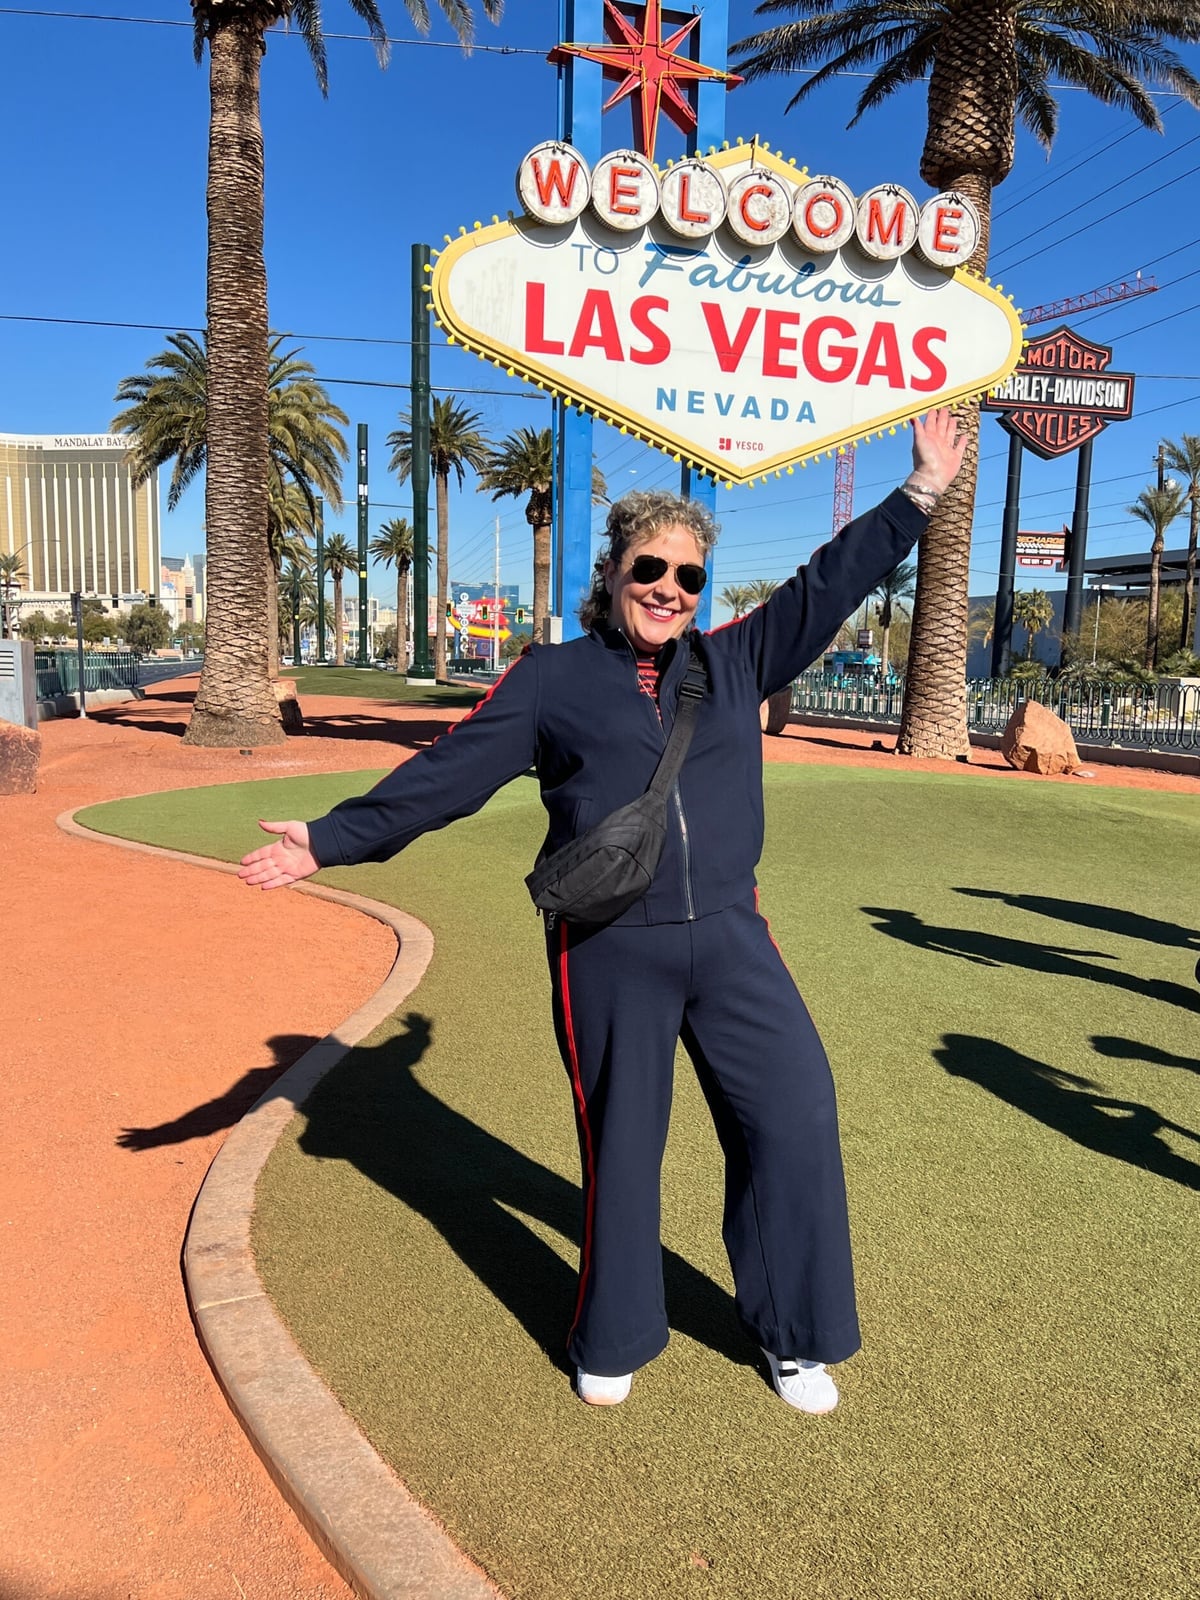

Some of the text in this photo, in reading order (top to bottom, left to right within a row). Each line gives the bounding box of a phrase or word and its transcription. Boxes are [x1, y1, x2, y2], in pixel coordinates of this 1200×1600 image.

[531, 156, 964, 253] WELCOME
[571, 242, 902, 307] TO Fabulous
[525, 281, 948, 393] LAS VEGAS
[1027, 338, 1097, 371] MOTOR
[656, 387, 816, 424] NEVADA
[54, 437, 124, 447] MANDALAY BAY
[735, 440, 764, 451] YESCO
[1022, 411, 1092, 446] CYCLES
